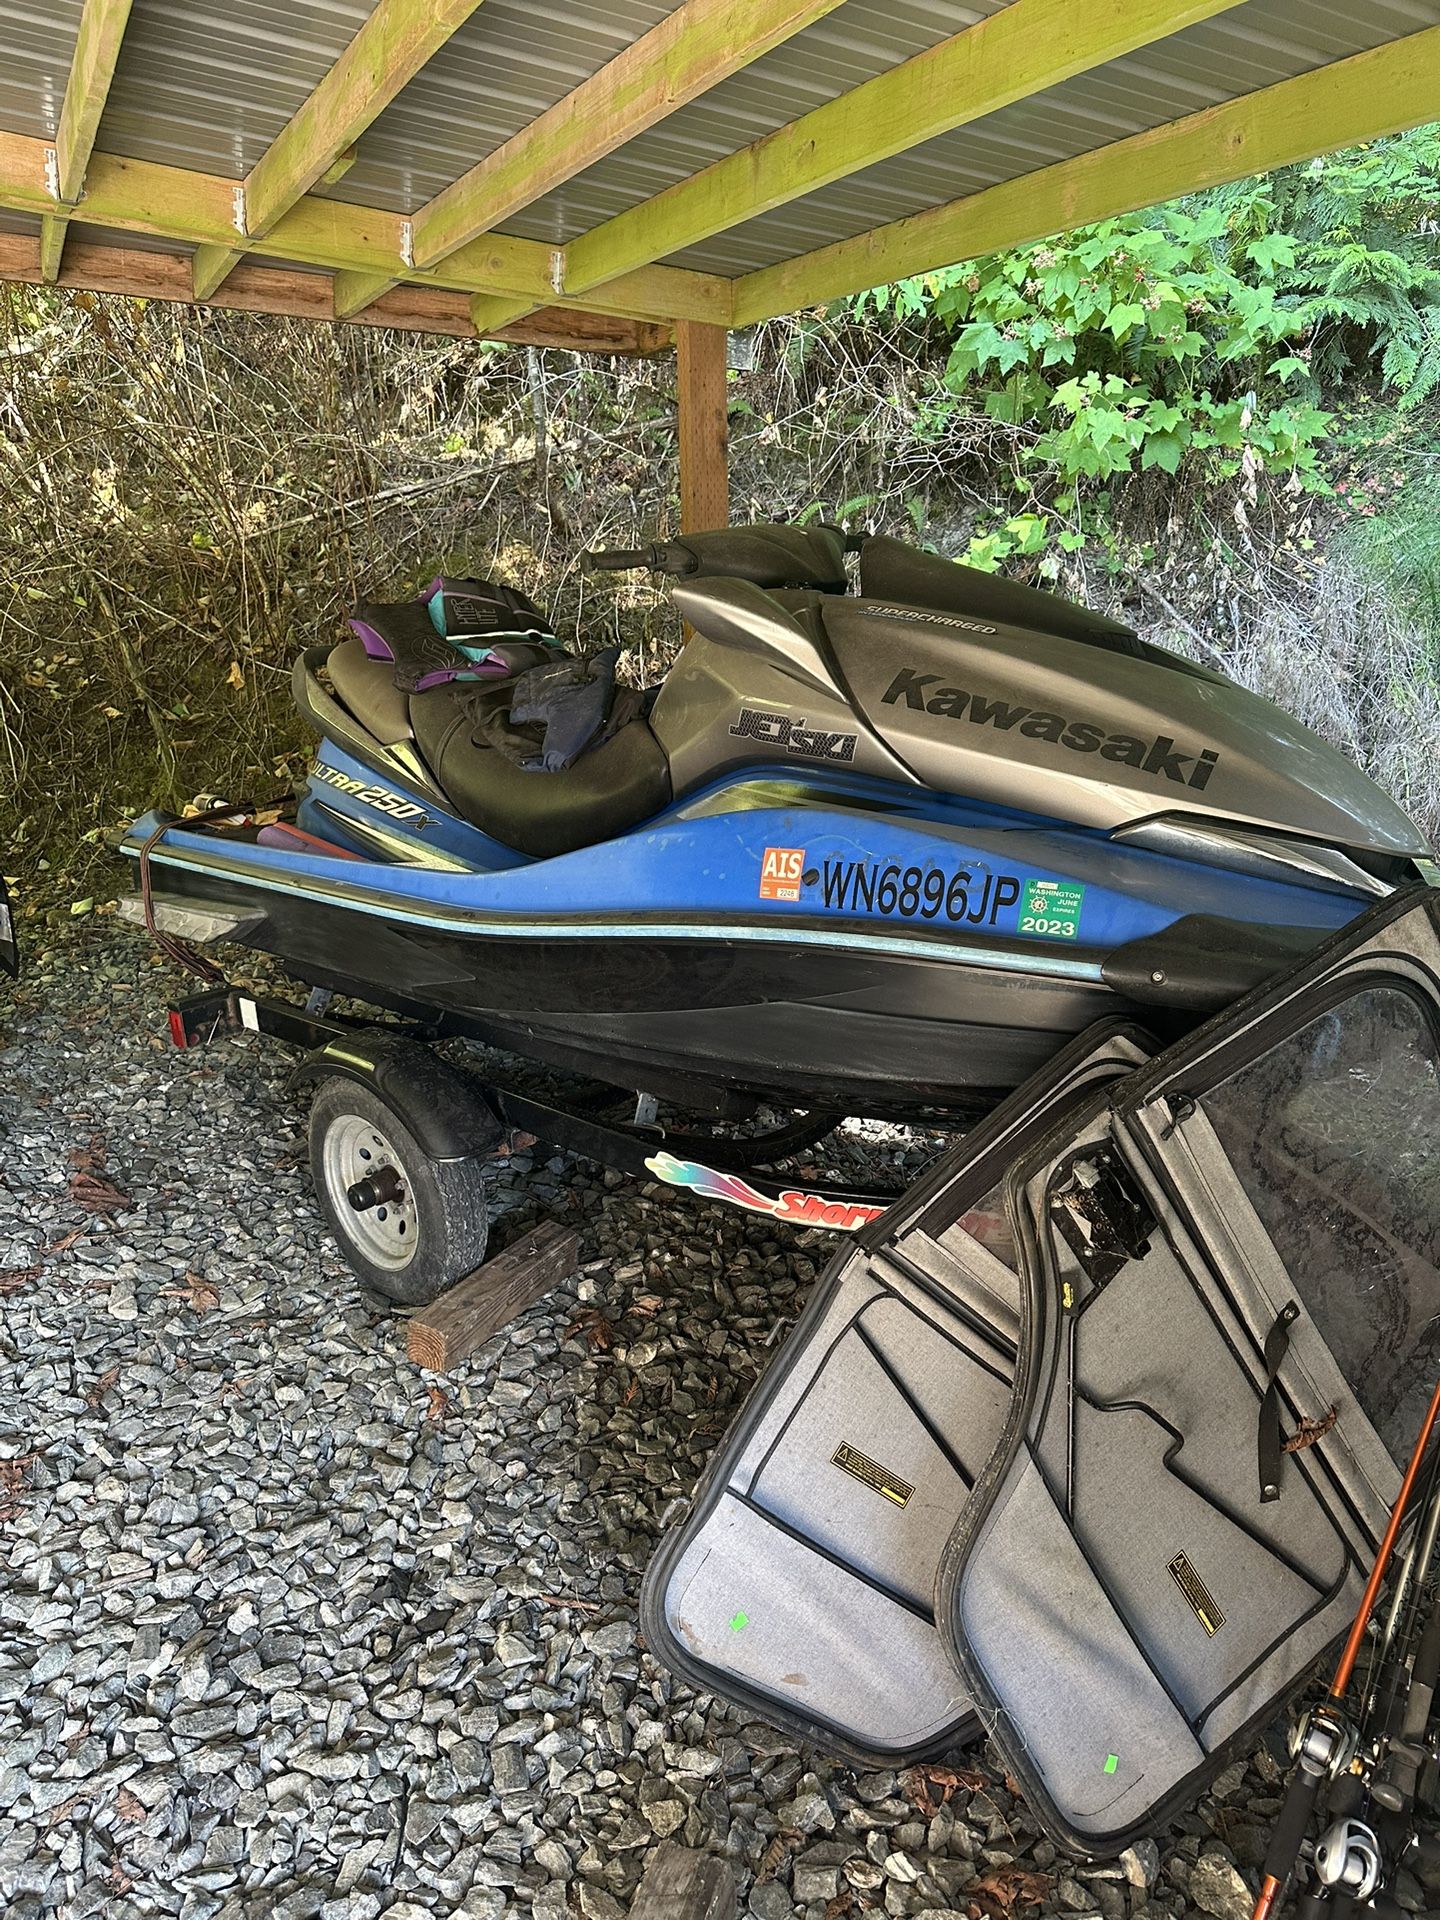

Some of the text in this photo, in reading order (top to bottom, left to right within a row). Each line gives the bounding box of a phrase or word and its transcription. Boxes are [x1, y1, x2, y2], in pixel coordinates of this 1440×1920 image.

[866, 604, 998, 635] SUPERCHARGED
[881, 668, 1220, 791] Kawasaki
[763, 852, 802, 879] AIS
[823, 860, 1020, 925] WN6896JP
[1028, 887, 1081, 899] WASHINGTON
[1057, 898, 1080, 907] JUNE
[1021, 916, 1075, 936] 2023
